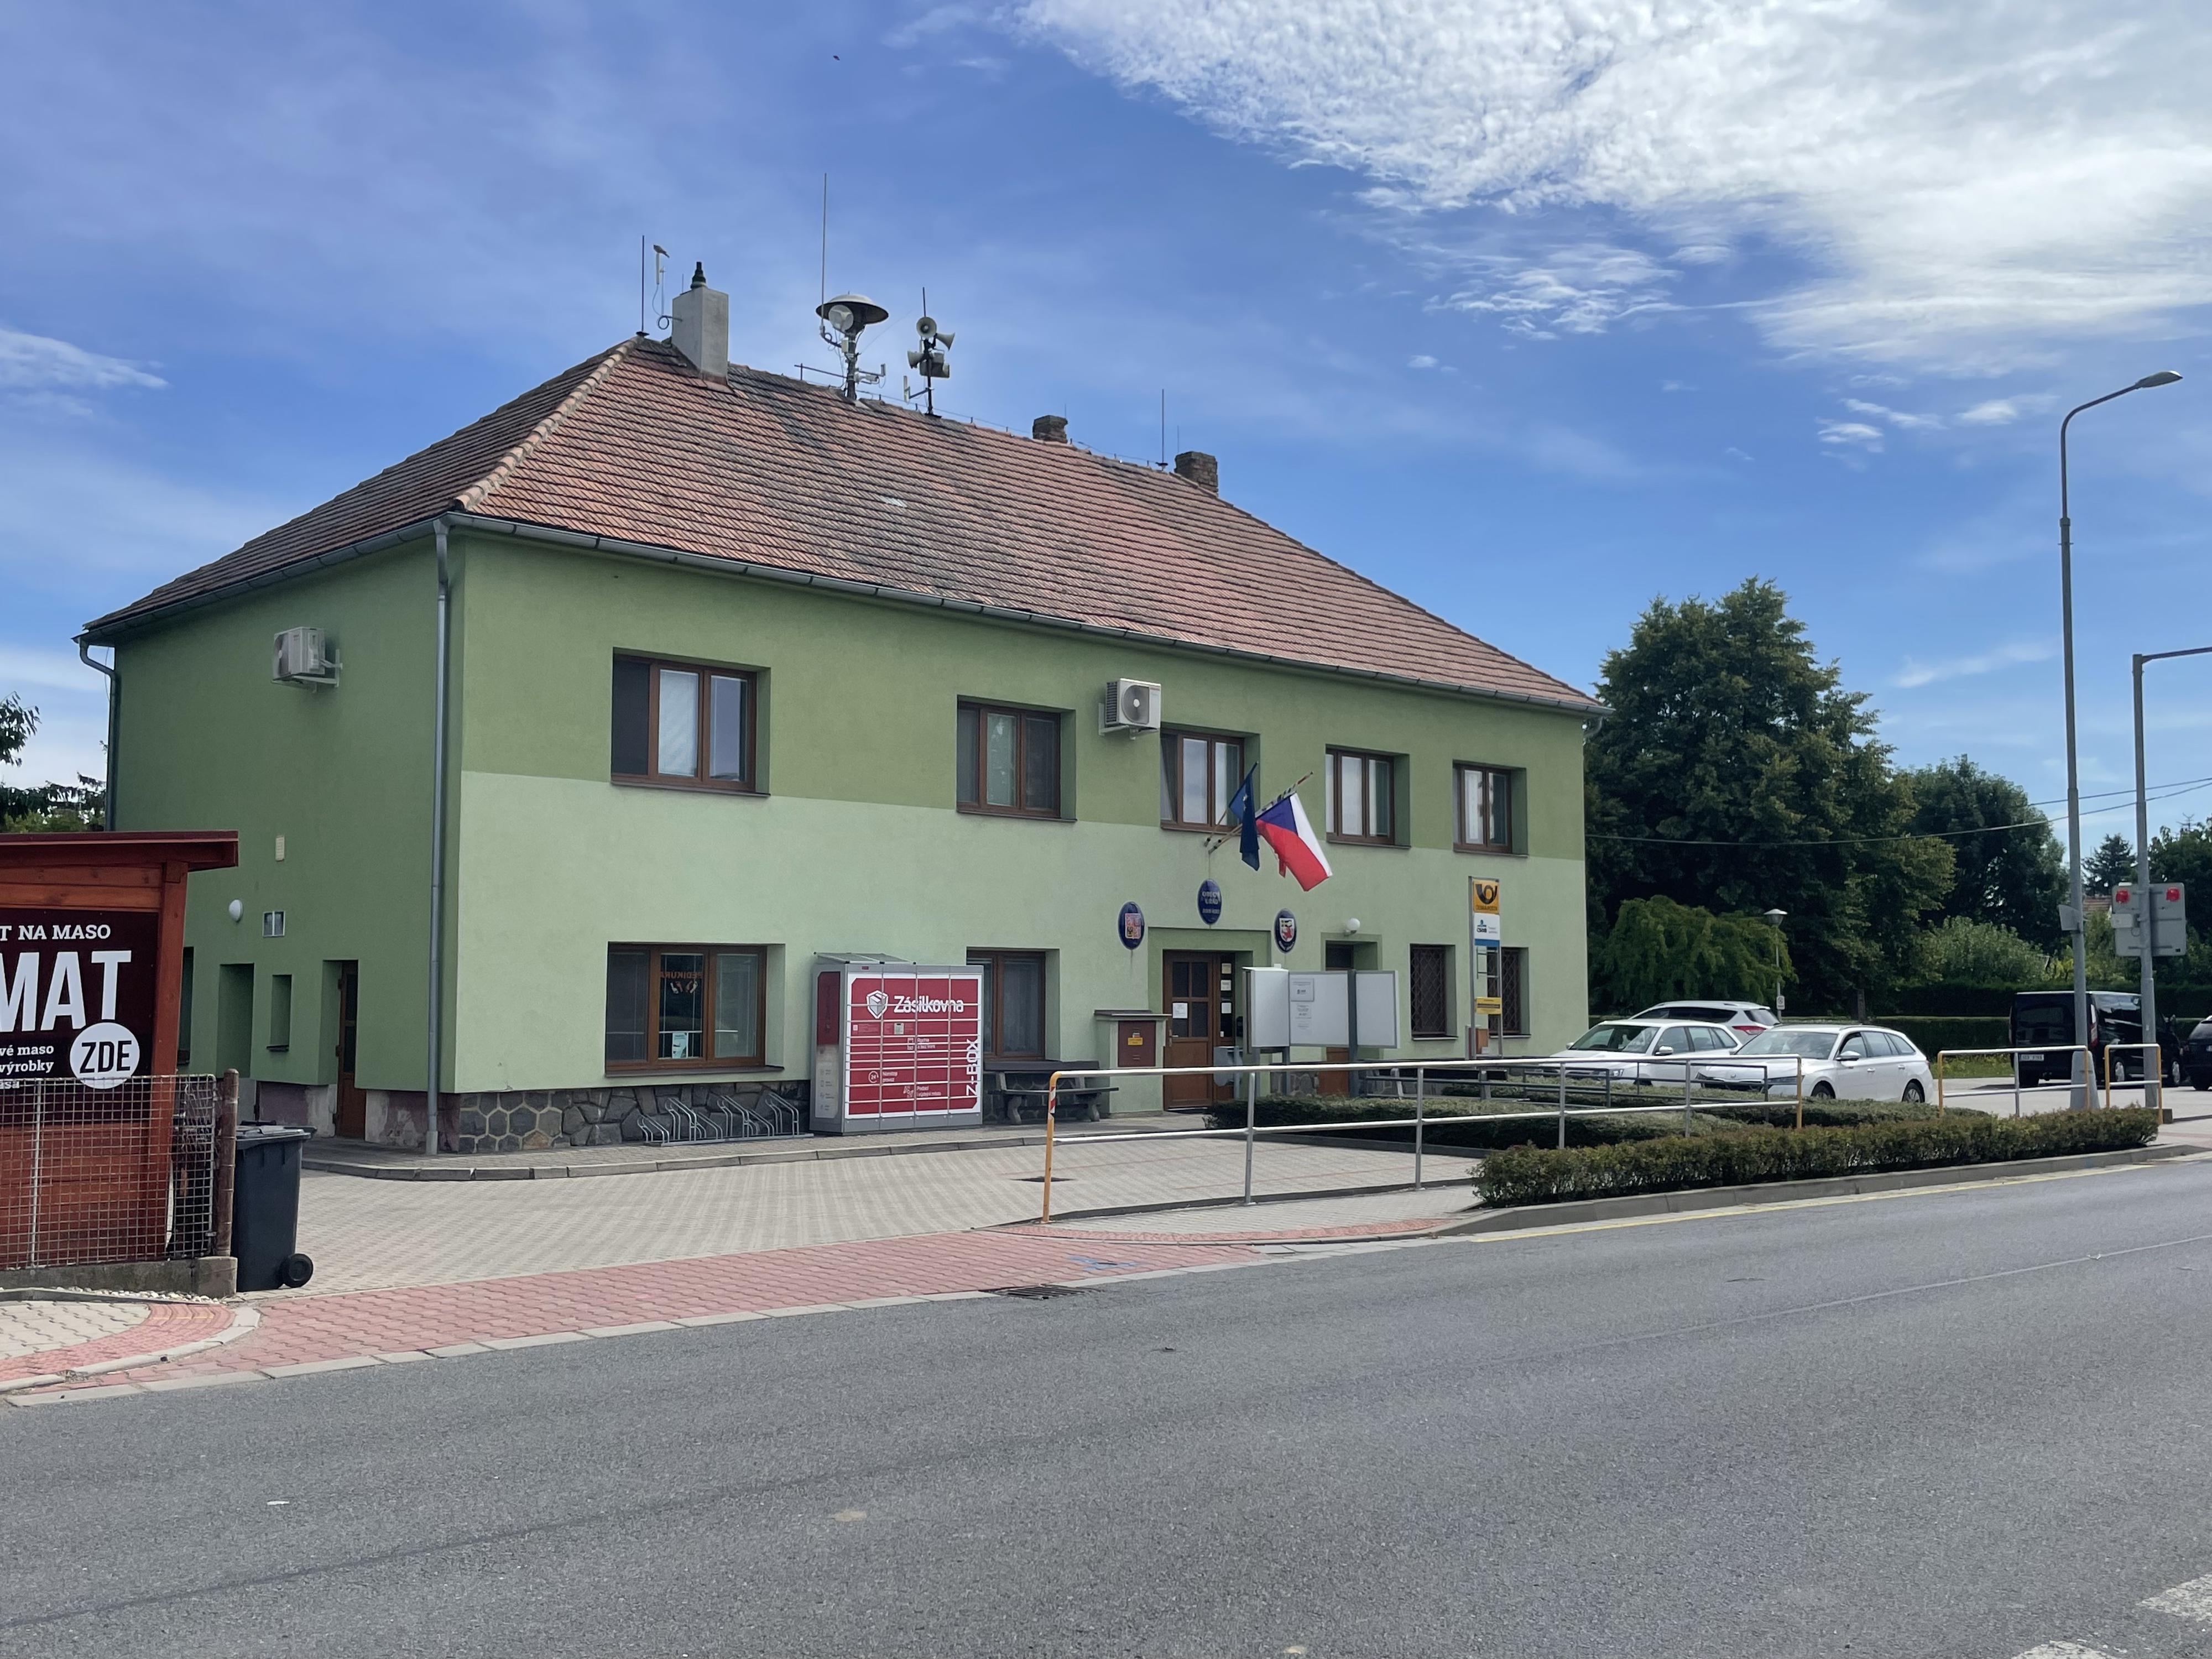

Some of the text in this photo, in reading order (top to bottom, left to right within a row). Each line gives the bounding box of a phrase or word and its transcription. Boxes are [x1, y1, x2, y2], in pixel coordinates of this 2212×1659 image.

[18, 925, 47, 940] NA
[52, 924, 111, 940] MASO
[894, 995, 964, 1013] Zásilkovna
[17, 1046, 54, 1056] maso
[80, 1040, 132, 1074] ZDE
[0, 1060, 54, 1076] výrobky
[966, 1039, 978, 1096] Z-BOX
